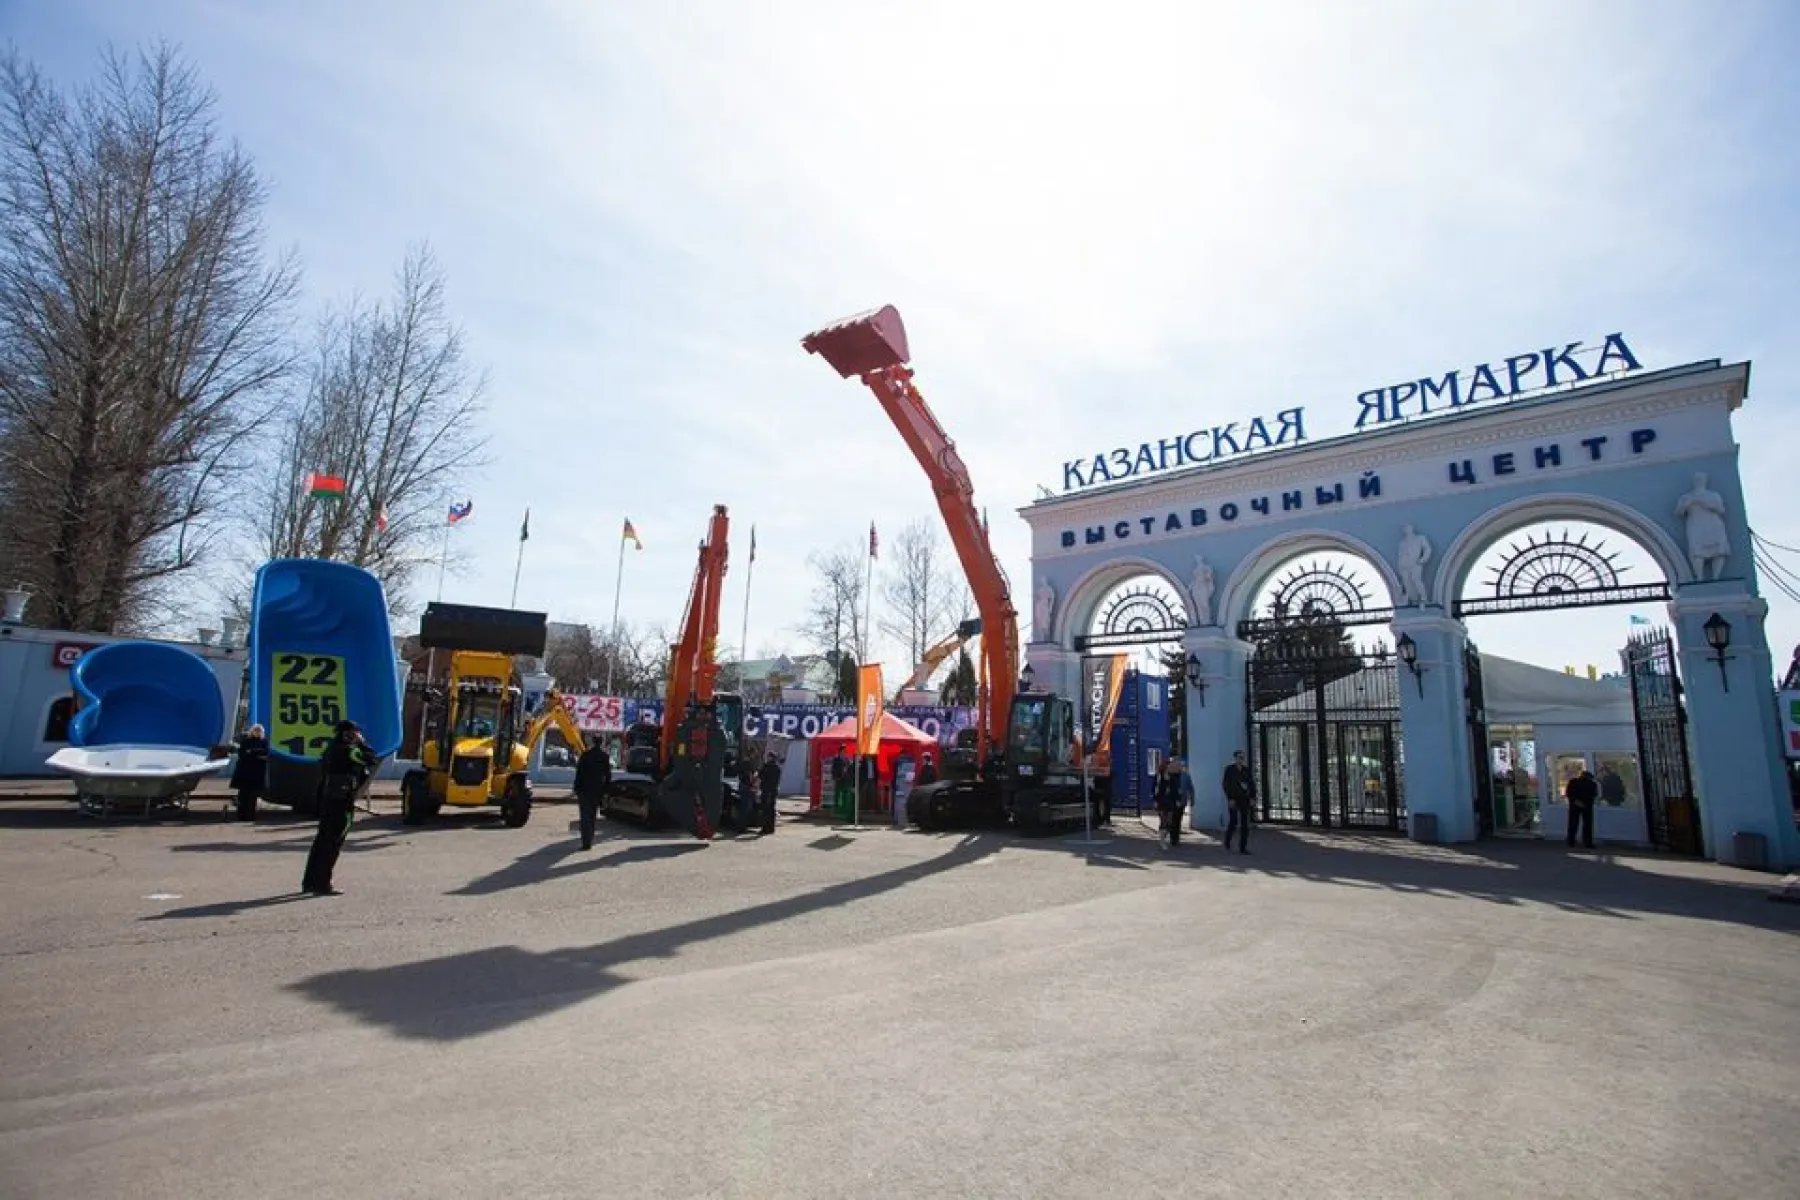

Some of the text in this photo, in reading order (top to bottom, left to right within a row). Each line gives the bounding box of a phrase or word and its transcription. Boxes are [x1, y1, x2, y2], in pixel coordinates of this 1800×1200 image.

[1062, 331, 1644, 490] КАЗАНСКАЯ ЯРМАРКА
[1061, 428, 1657, 548] ВЫСТАВОЧНЫЙ ЦЕНТР
[279, 654, 338, 686] 22
[279, 693, 341, 726] 555
